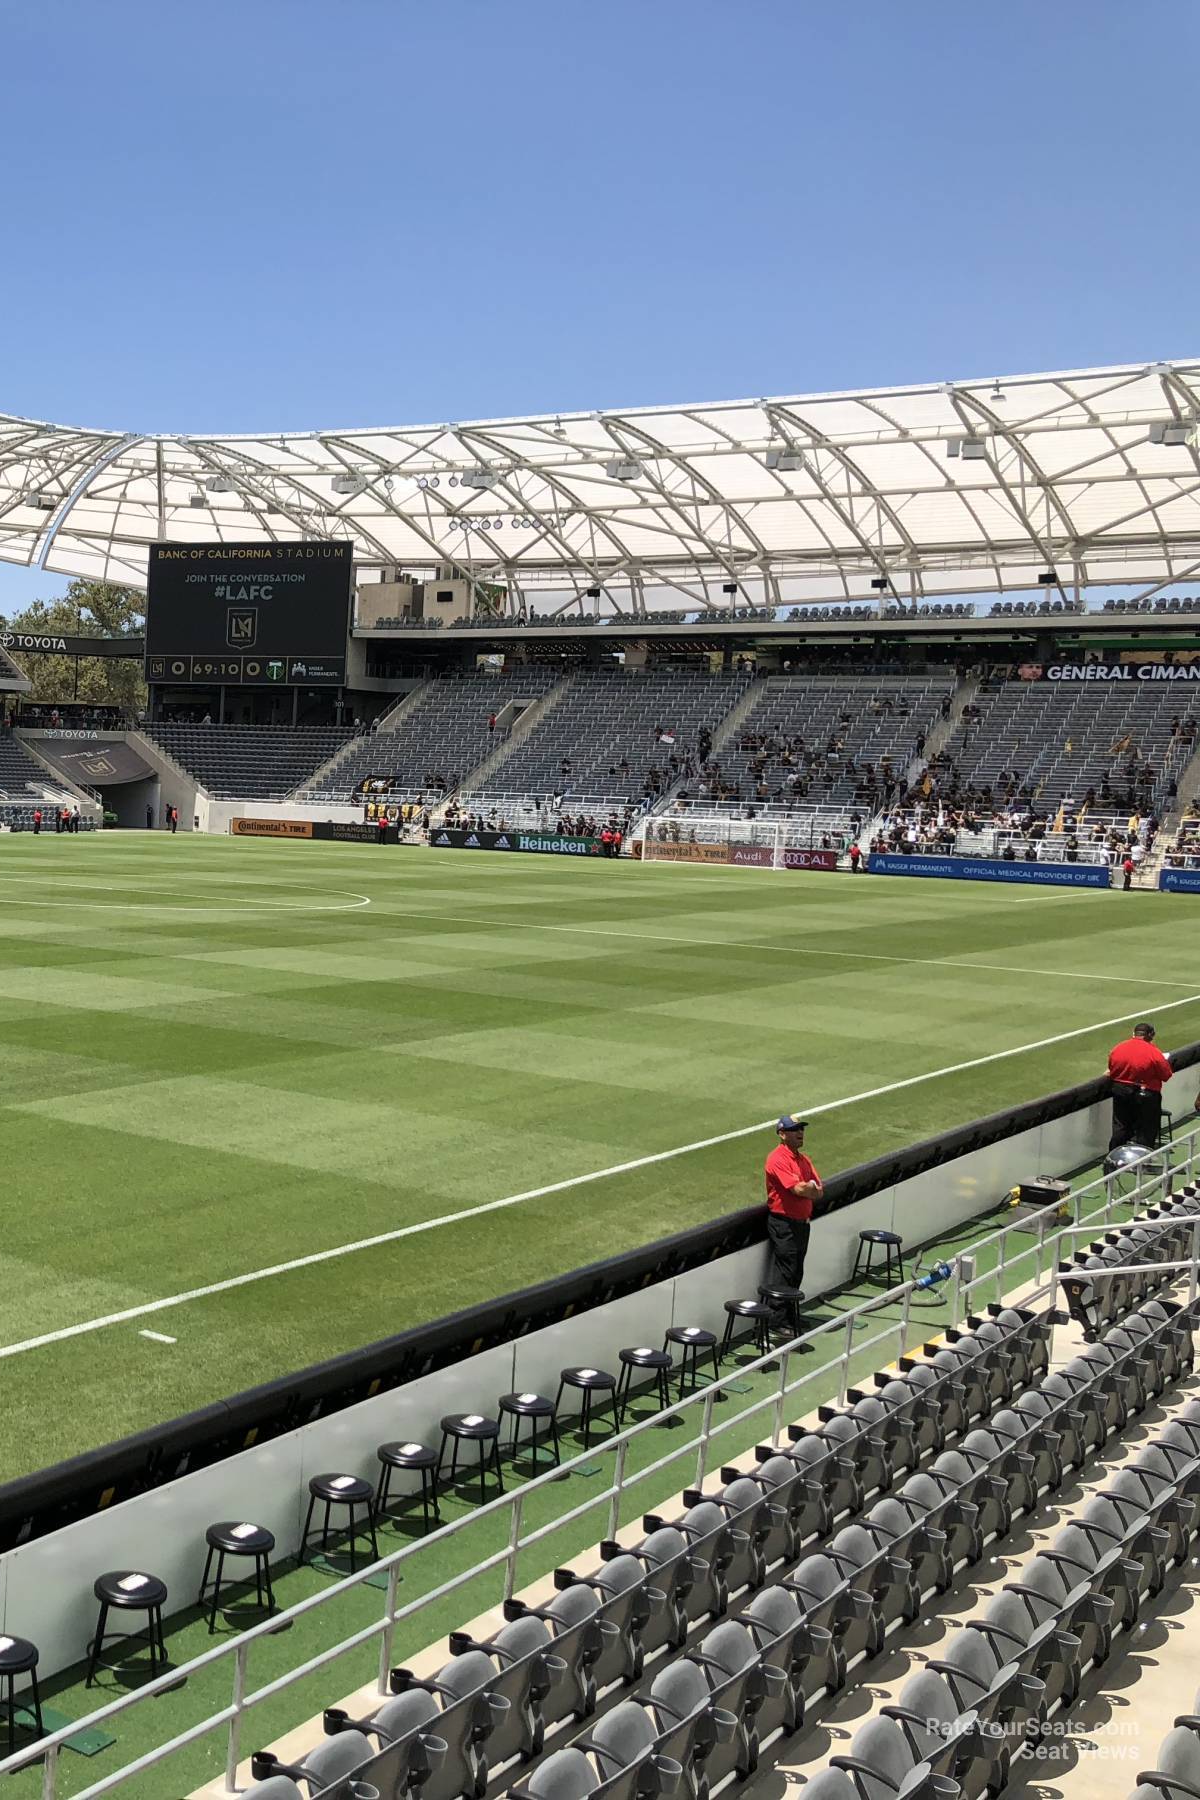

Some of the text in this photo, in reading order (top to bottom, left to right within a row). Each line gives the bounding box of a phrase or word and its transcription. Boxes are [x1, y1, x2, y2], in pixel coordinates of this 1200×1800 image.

[158, 548, 344, 559] BANC OF CALIFORNIA STADIUM
[185, 574, 306, 583] JOIN THE CONVERSATION
[214, 585, 273, 600] #LAFC
[17, 635, 67, 650] TOYOTA
[171, 661, 185, 675] 0
[194, 663, 239, 675] 69:10
[246, 662, 260, 676] 0
[1047, 664, 1132, 680] GÉNÉRAL
[60, 730, 98, 739] TOYOTA
[238, 820, 280, 833] Continental
[333, 825, 376, 834] LOS ANGELES
[519, 836, 586, 853] Heineken
[734, 850, 762, 861] Audi
[963, 866, 996, 875] OFFICIAL
[998, 868, 1032, 878] MEDICAL
[1033, 871, 1073, 880] PROVIDER
[1075, 873, 1087, 881] OF
